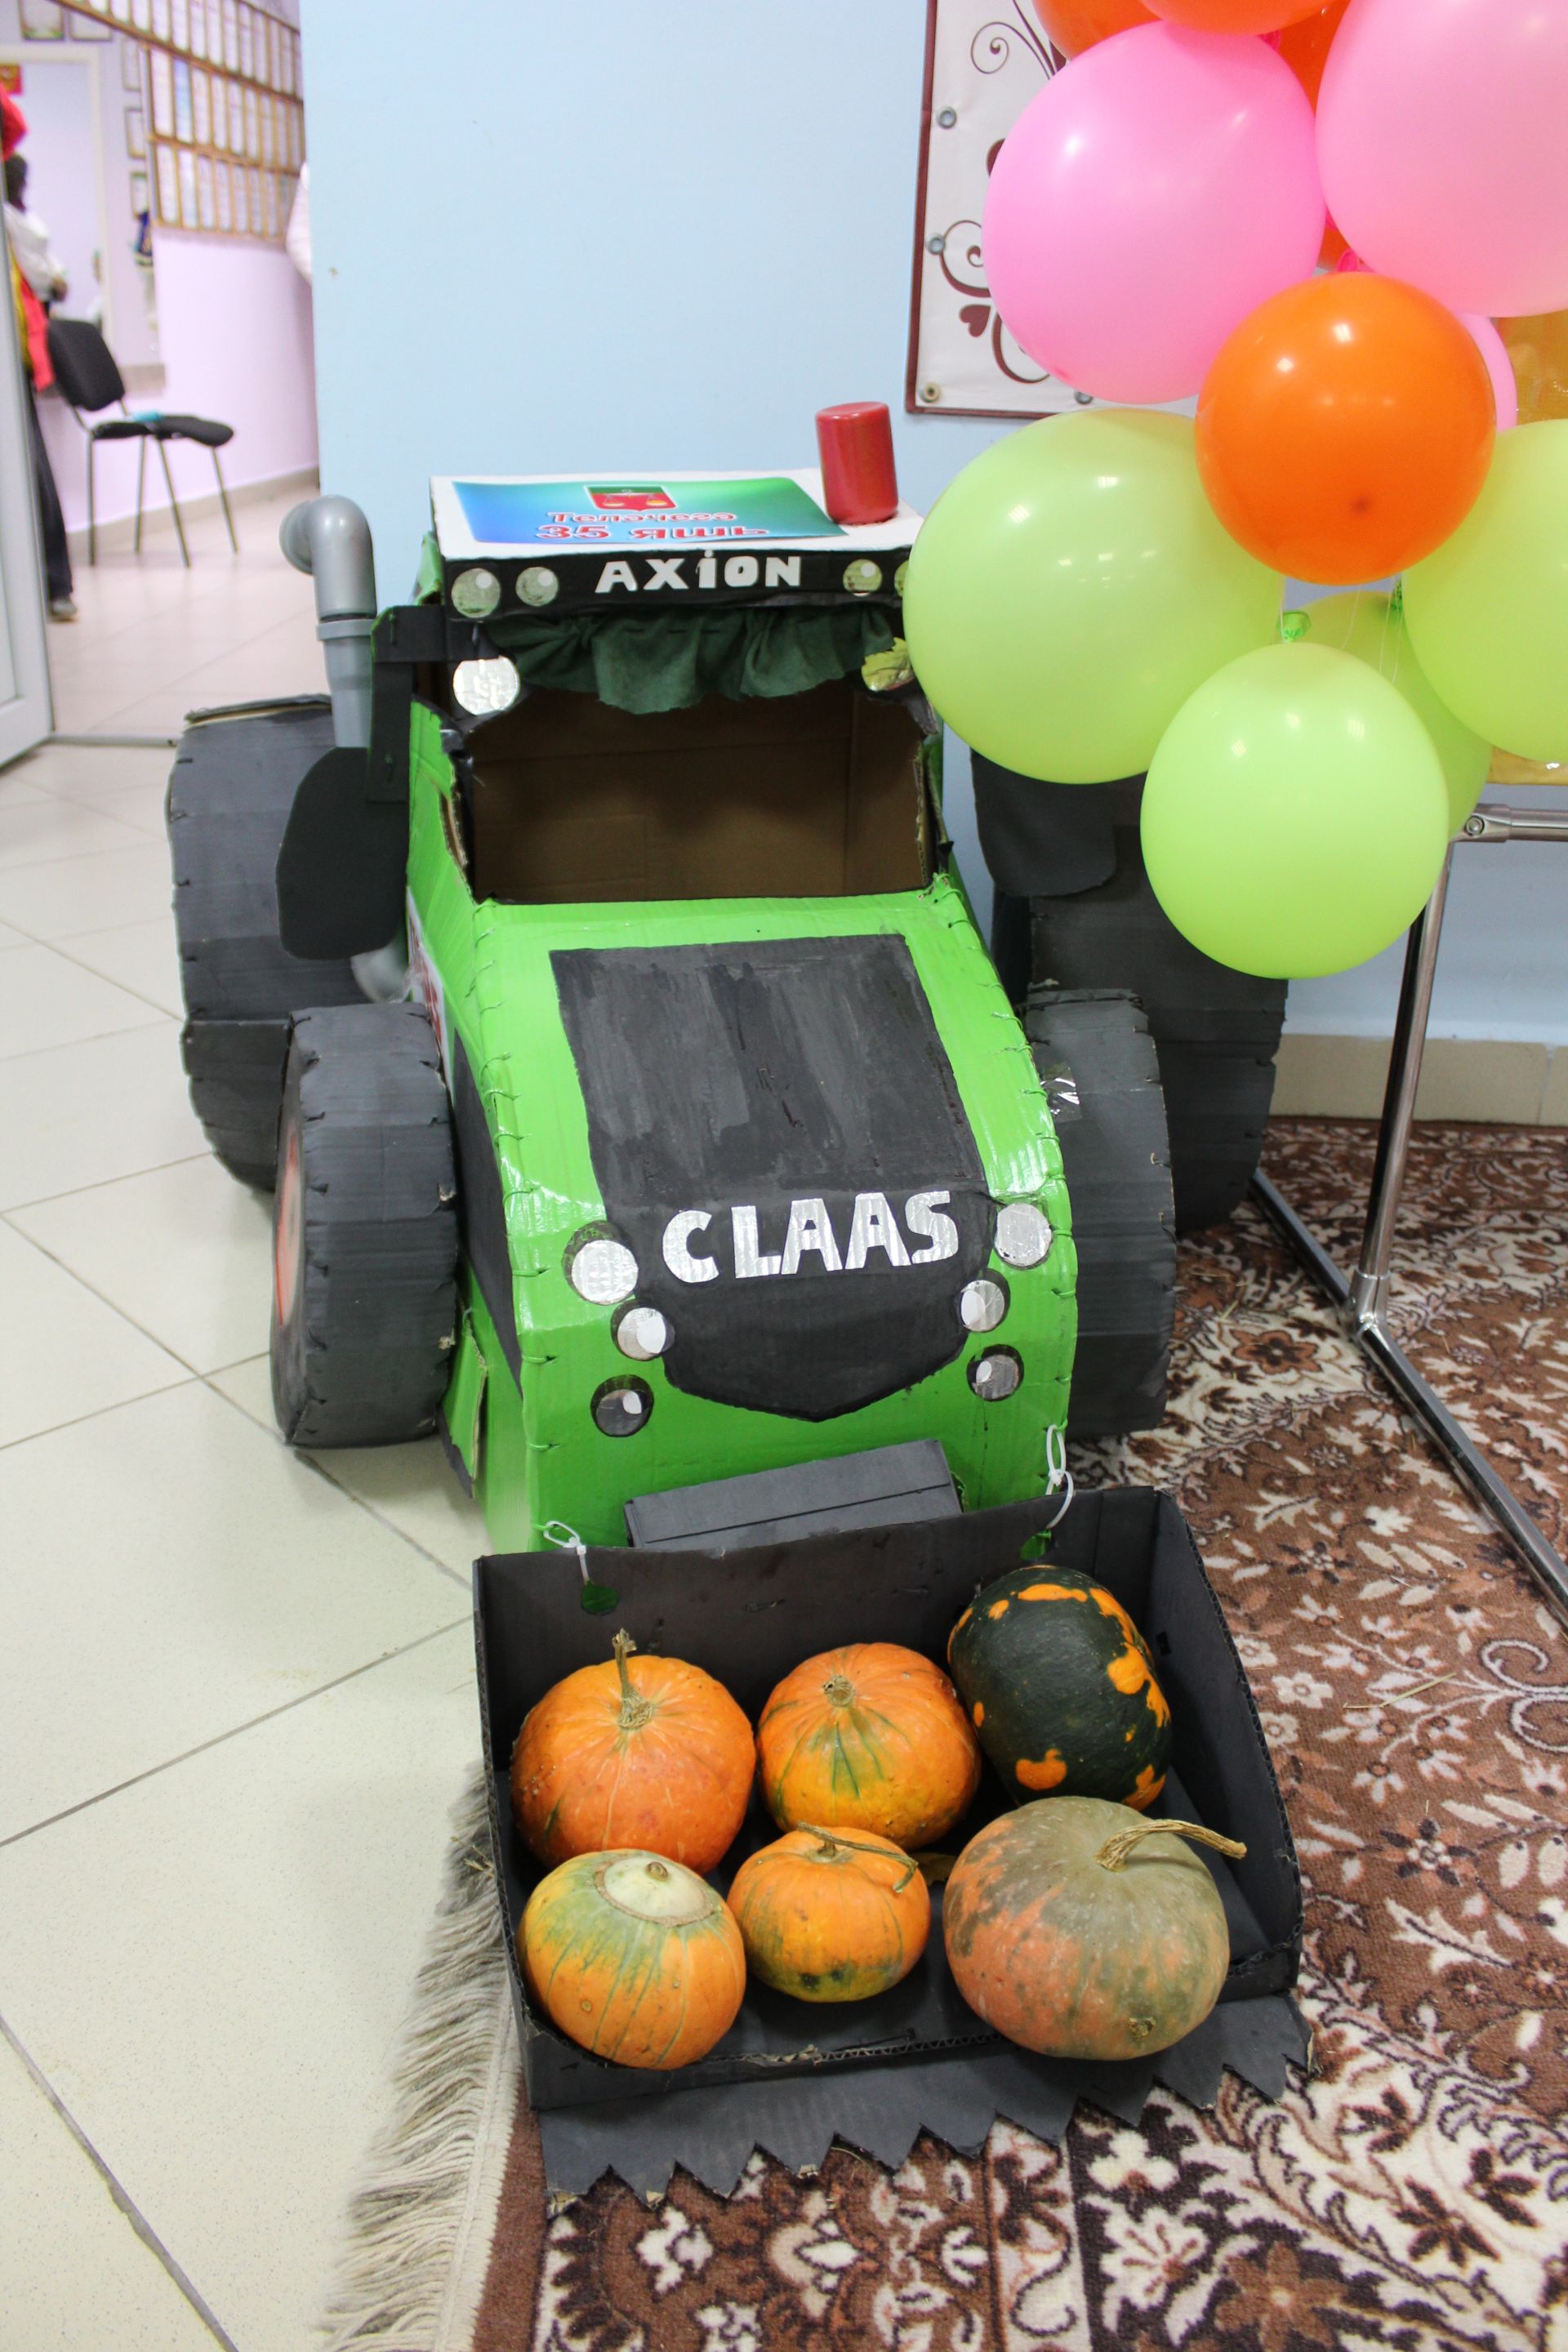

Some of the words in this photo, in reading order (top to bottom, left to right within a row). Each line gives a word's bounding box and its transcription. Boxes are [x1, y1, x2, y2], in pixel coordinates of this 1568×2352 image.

[536, 525, 611, 540] 35
[630, 526, 769, 540] яшь
[662, 1190, 960, 1284] CLAAS
